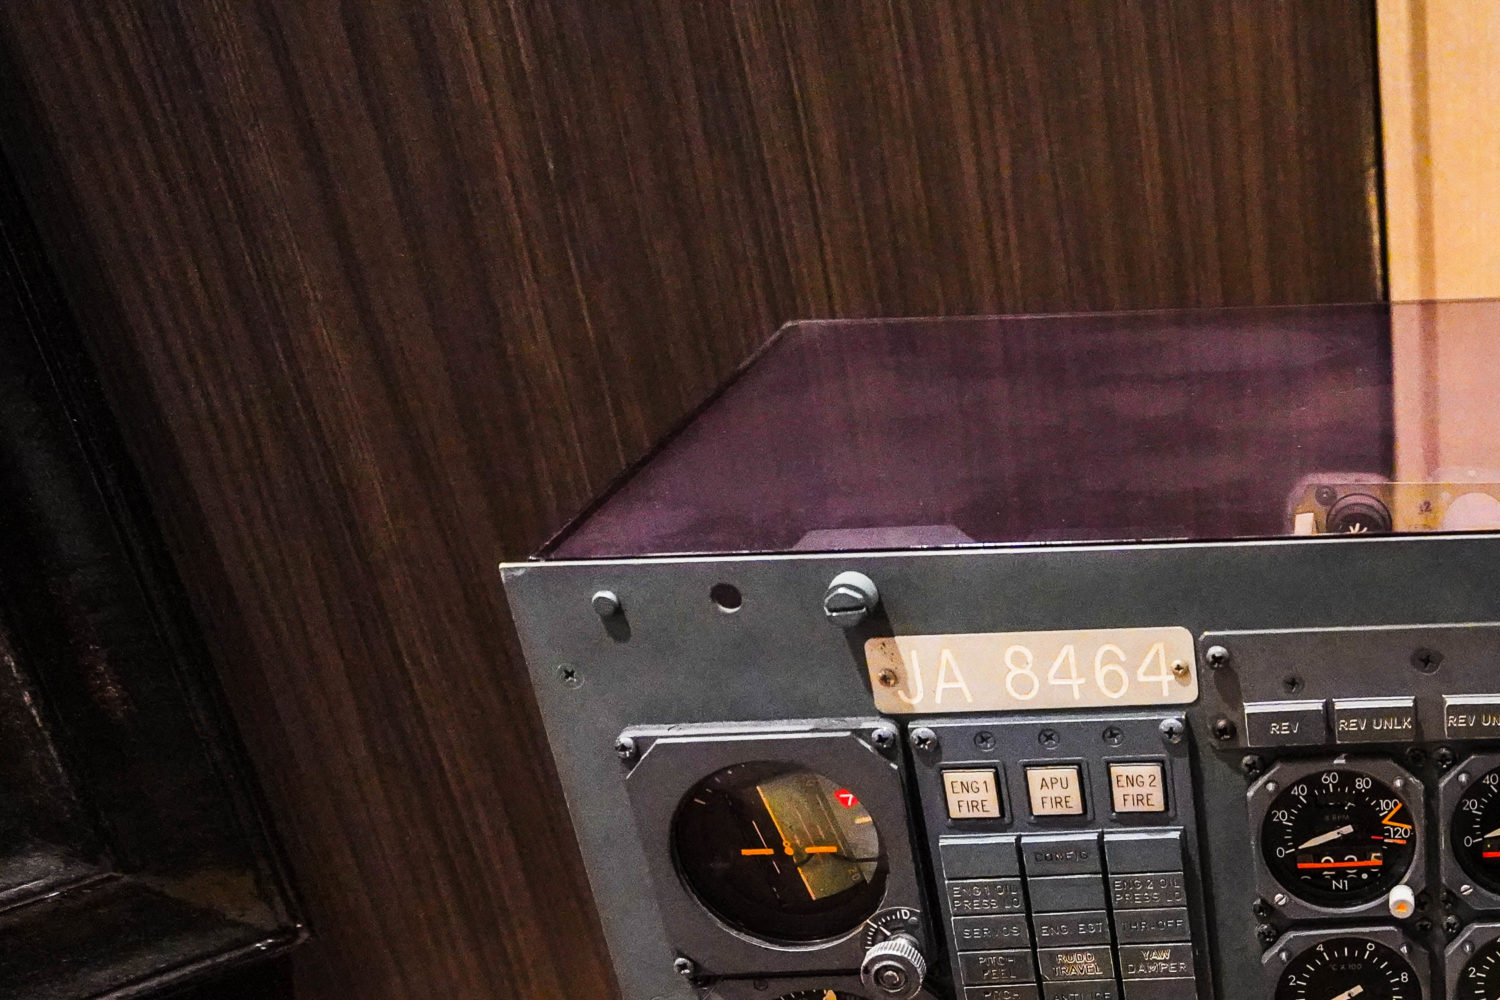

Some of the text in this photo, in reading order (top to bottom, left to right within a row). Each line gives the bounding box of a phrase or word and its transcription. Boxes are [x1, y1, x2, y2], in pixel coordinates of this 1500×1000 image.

[897, 641, 1176, 705] JA 8464
[1270, 721, 1300, 735] REV
[1338, 716, 1413, 731] REV UNLK
[1447, 714, 1476, 728] REV
[1040, 777, 1069, 791] APU
[1115, 774, 1144, 788] ENG
[957, 799, 991, 814] FIRE
[1041, 796, 1074, 810] FIRE
[1122, 793, 1155, 807] FIRE
[1332, 878, 1350, 892] N1
[1141, 949, 1171, 961] YAW
[1052, 964, 1104, 976] TRAVEL
[1128, 962, 1187, 974] DAMPER
